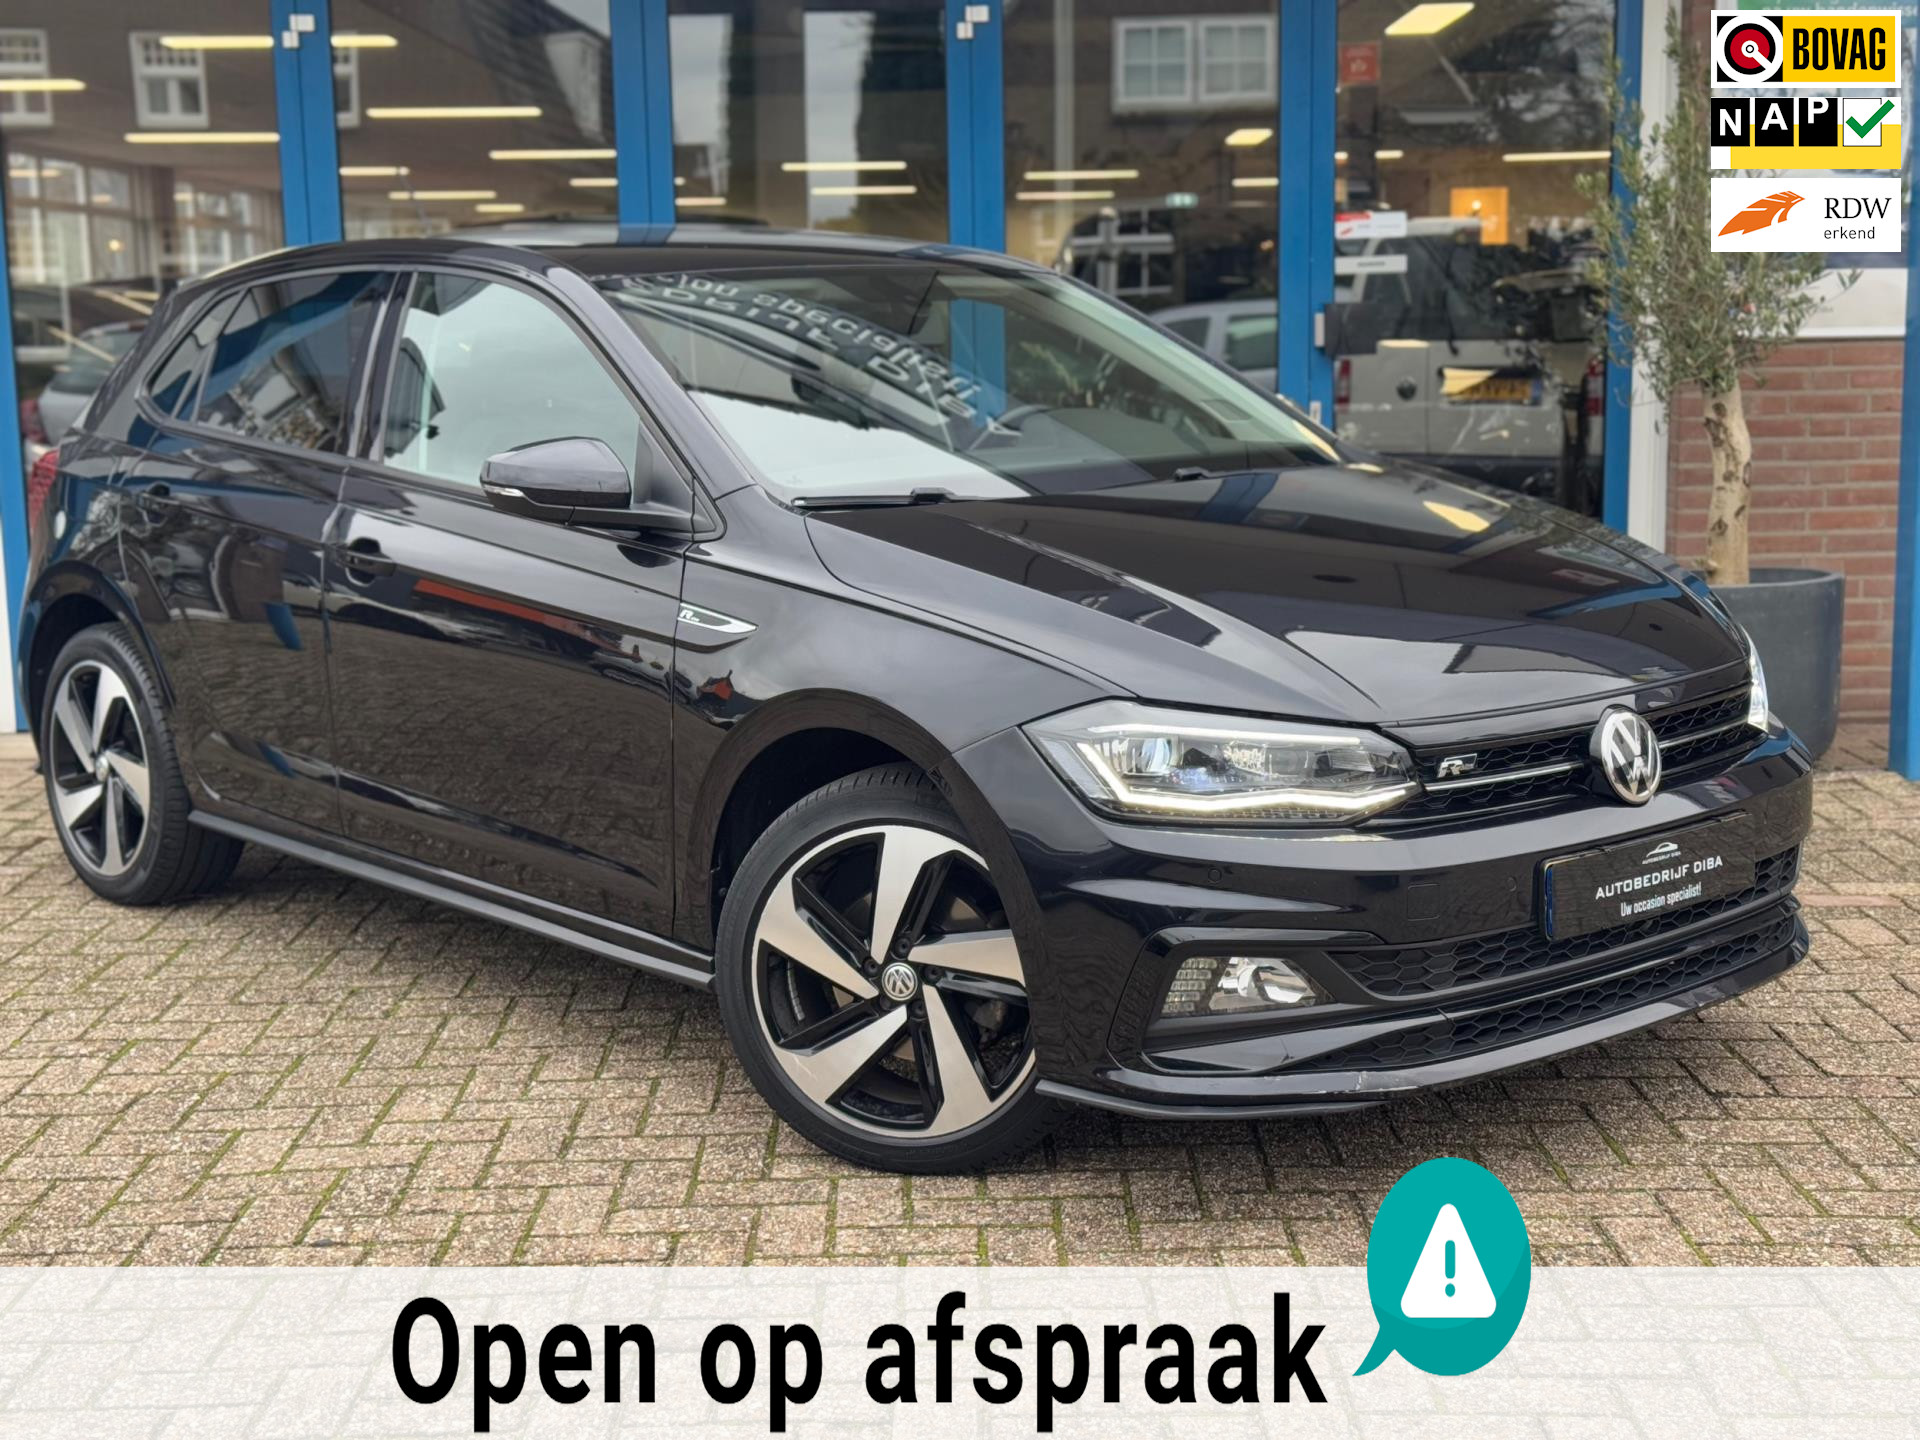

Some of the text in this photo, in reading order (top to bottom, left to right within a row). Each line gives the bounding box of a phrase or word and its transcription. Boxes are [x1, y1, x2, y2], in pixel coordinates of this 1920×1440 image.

[1595, 855, 1723, 900] AUTOBEDRIJF DIBA
[1620, 881, 1702, 917] Uw occasion specialist!
